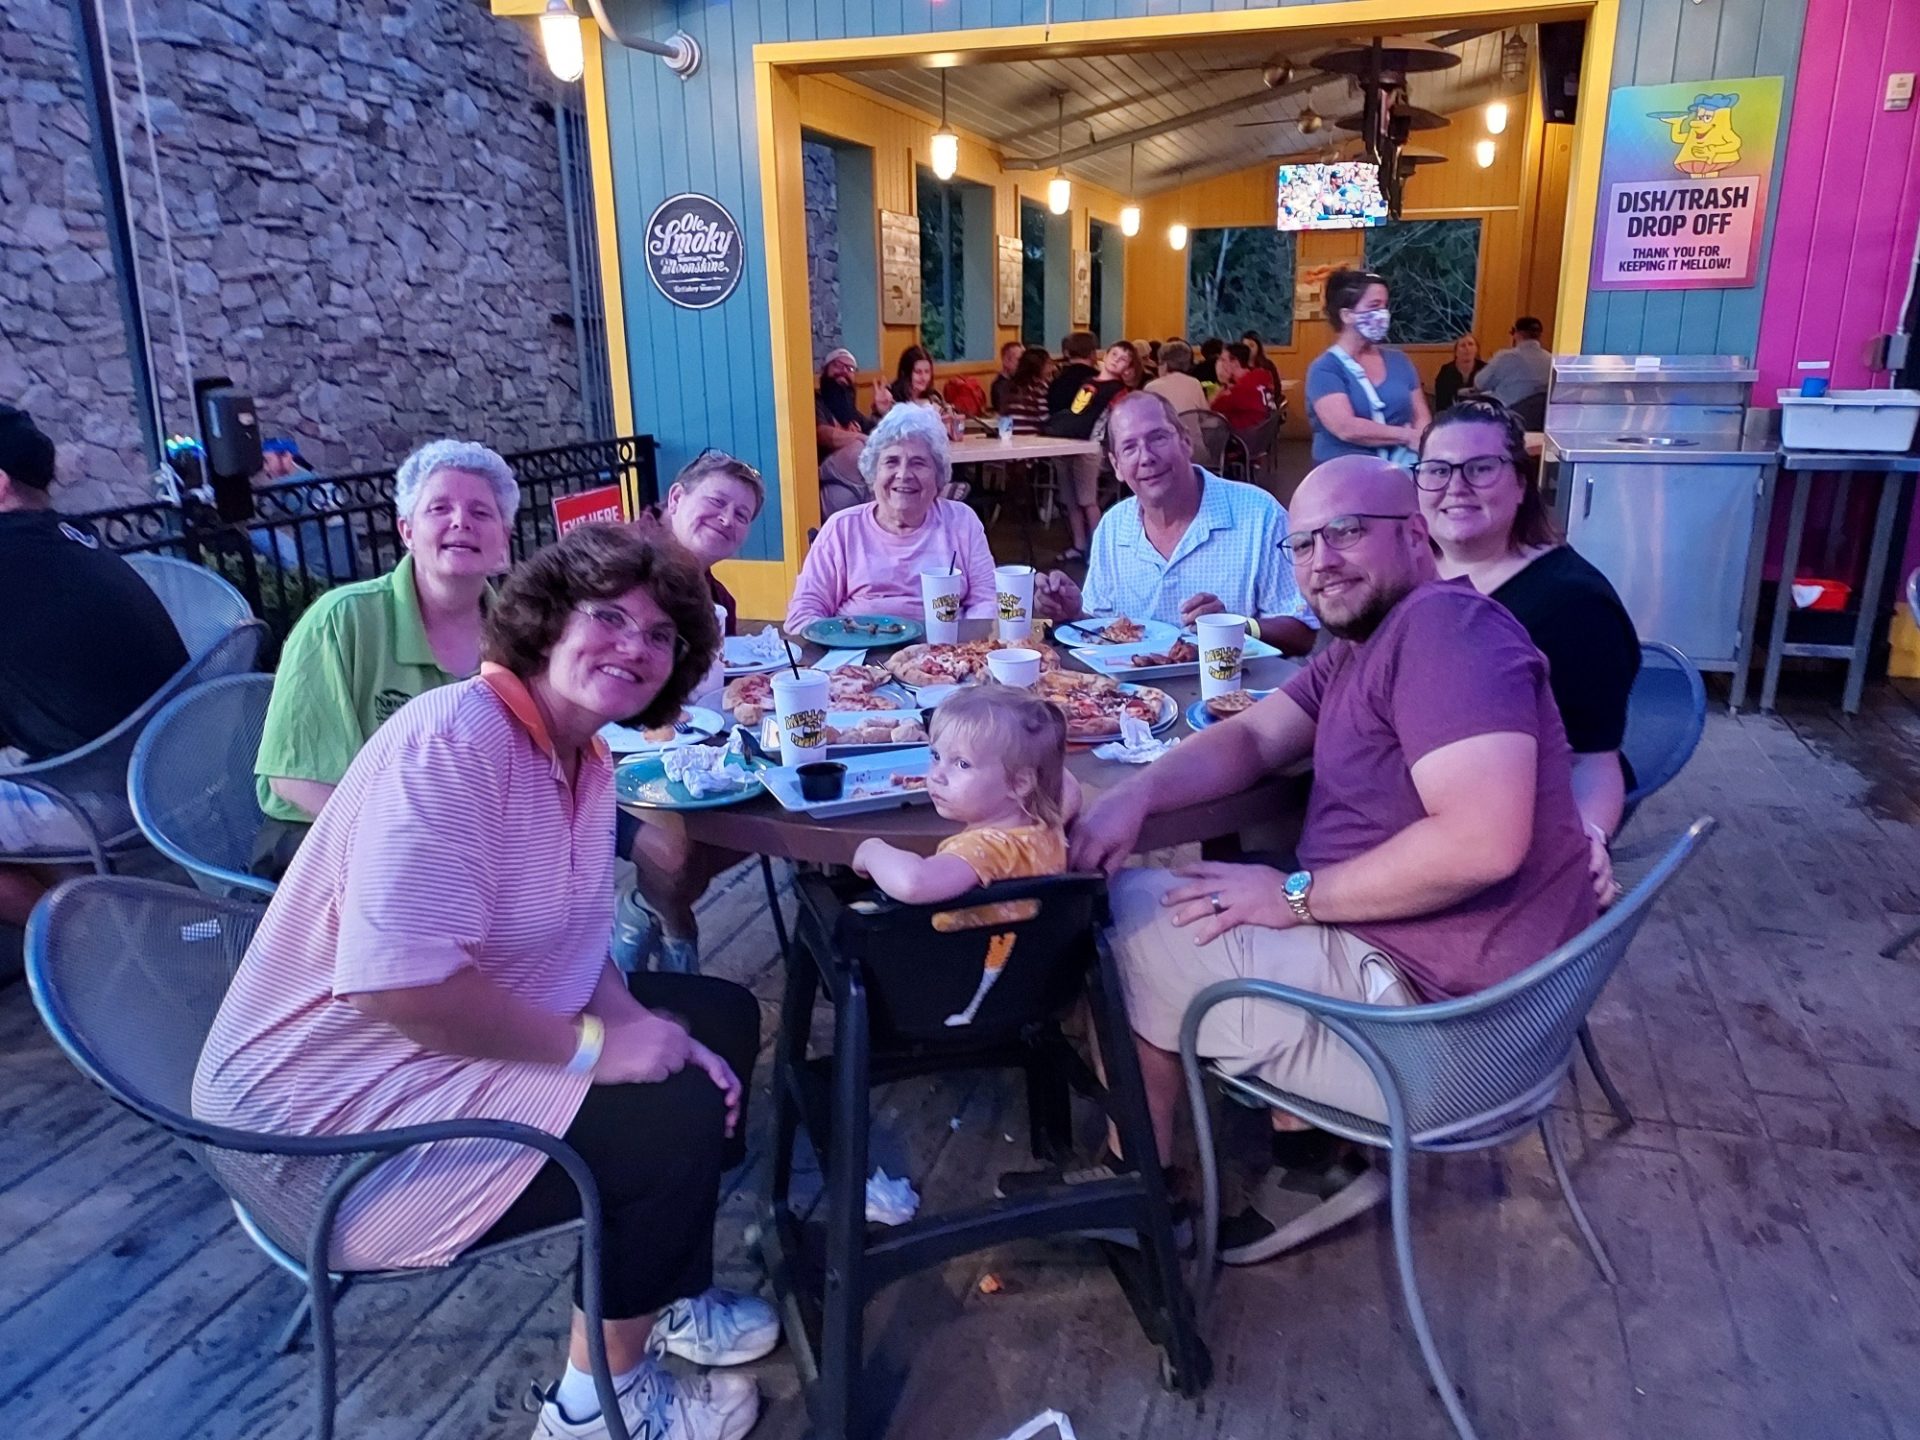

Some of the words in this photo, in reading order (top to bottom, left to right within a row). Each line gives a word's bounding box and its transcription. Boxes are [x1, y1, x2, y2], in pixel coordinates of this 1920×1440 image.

[1617, 186, 1750, 213] DISH/TRASH
[681, 212, 709, 232] Ole
[1627, 215, 1687, 237] DROP
[1692, 213, 1733, 235] OFF
[649, 219, 734, 259] Smoky
[1632, 247, 1669, 259] THANK
[1673, 246, 1696, 258] YOU
[1698, 245, 1720, 257] FOR
[660, 257, 730, 275] Moonshine
[1618, 260, 1666, 272] KEEPING
[1668, 259, 1679, 271] IT
[1680, 257, 1731, 271] MELLOW!
[1204, 646, 1242, 663] MELLO
[784, 708, 827, 730] MELLO
